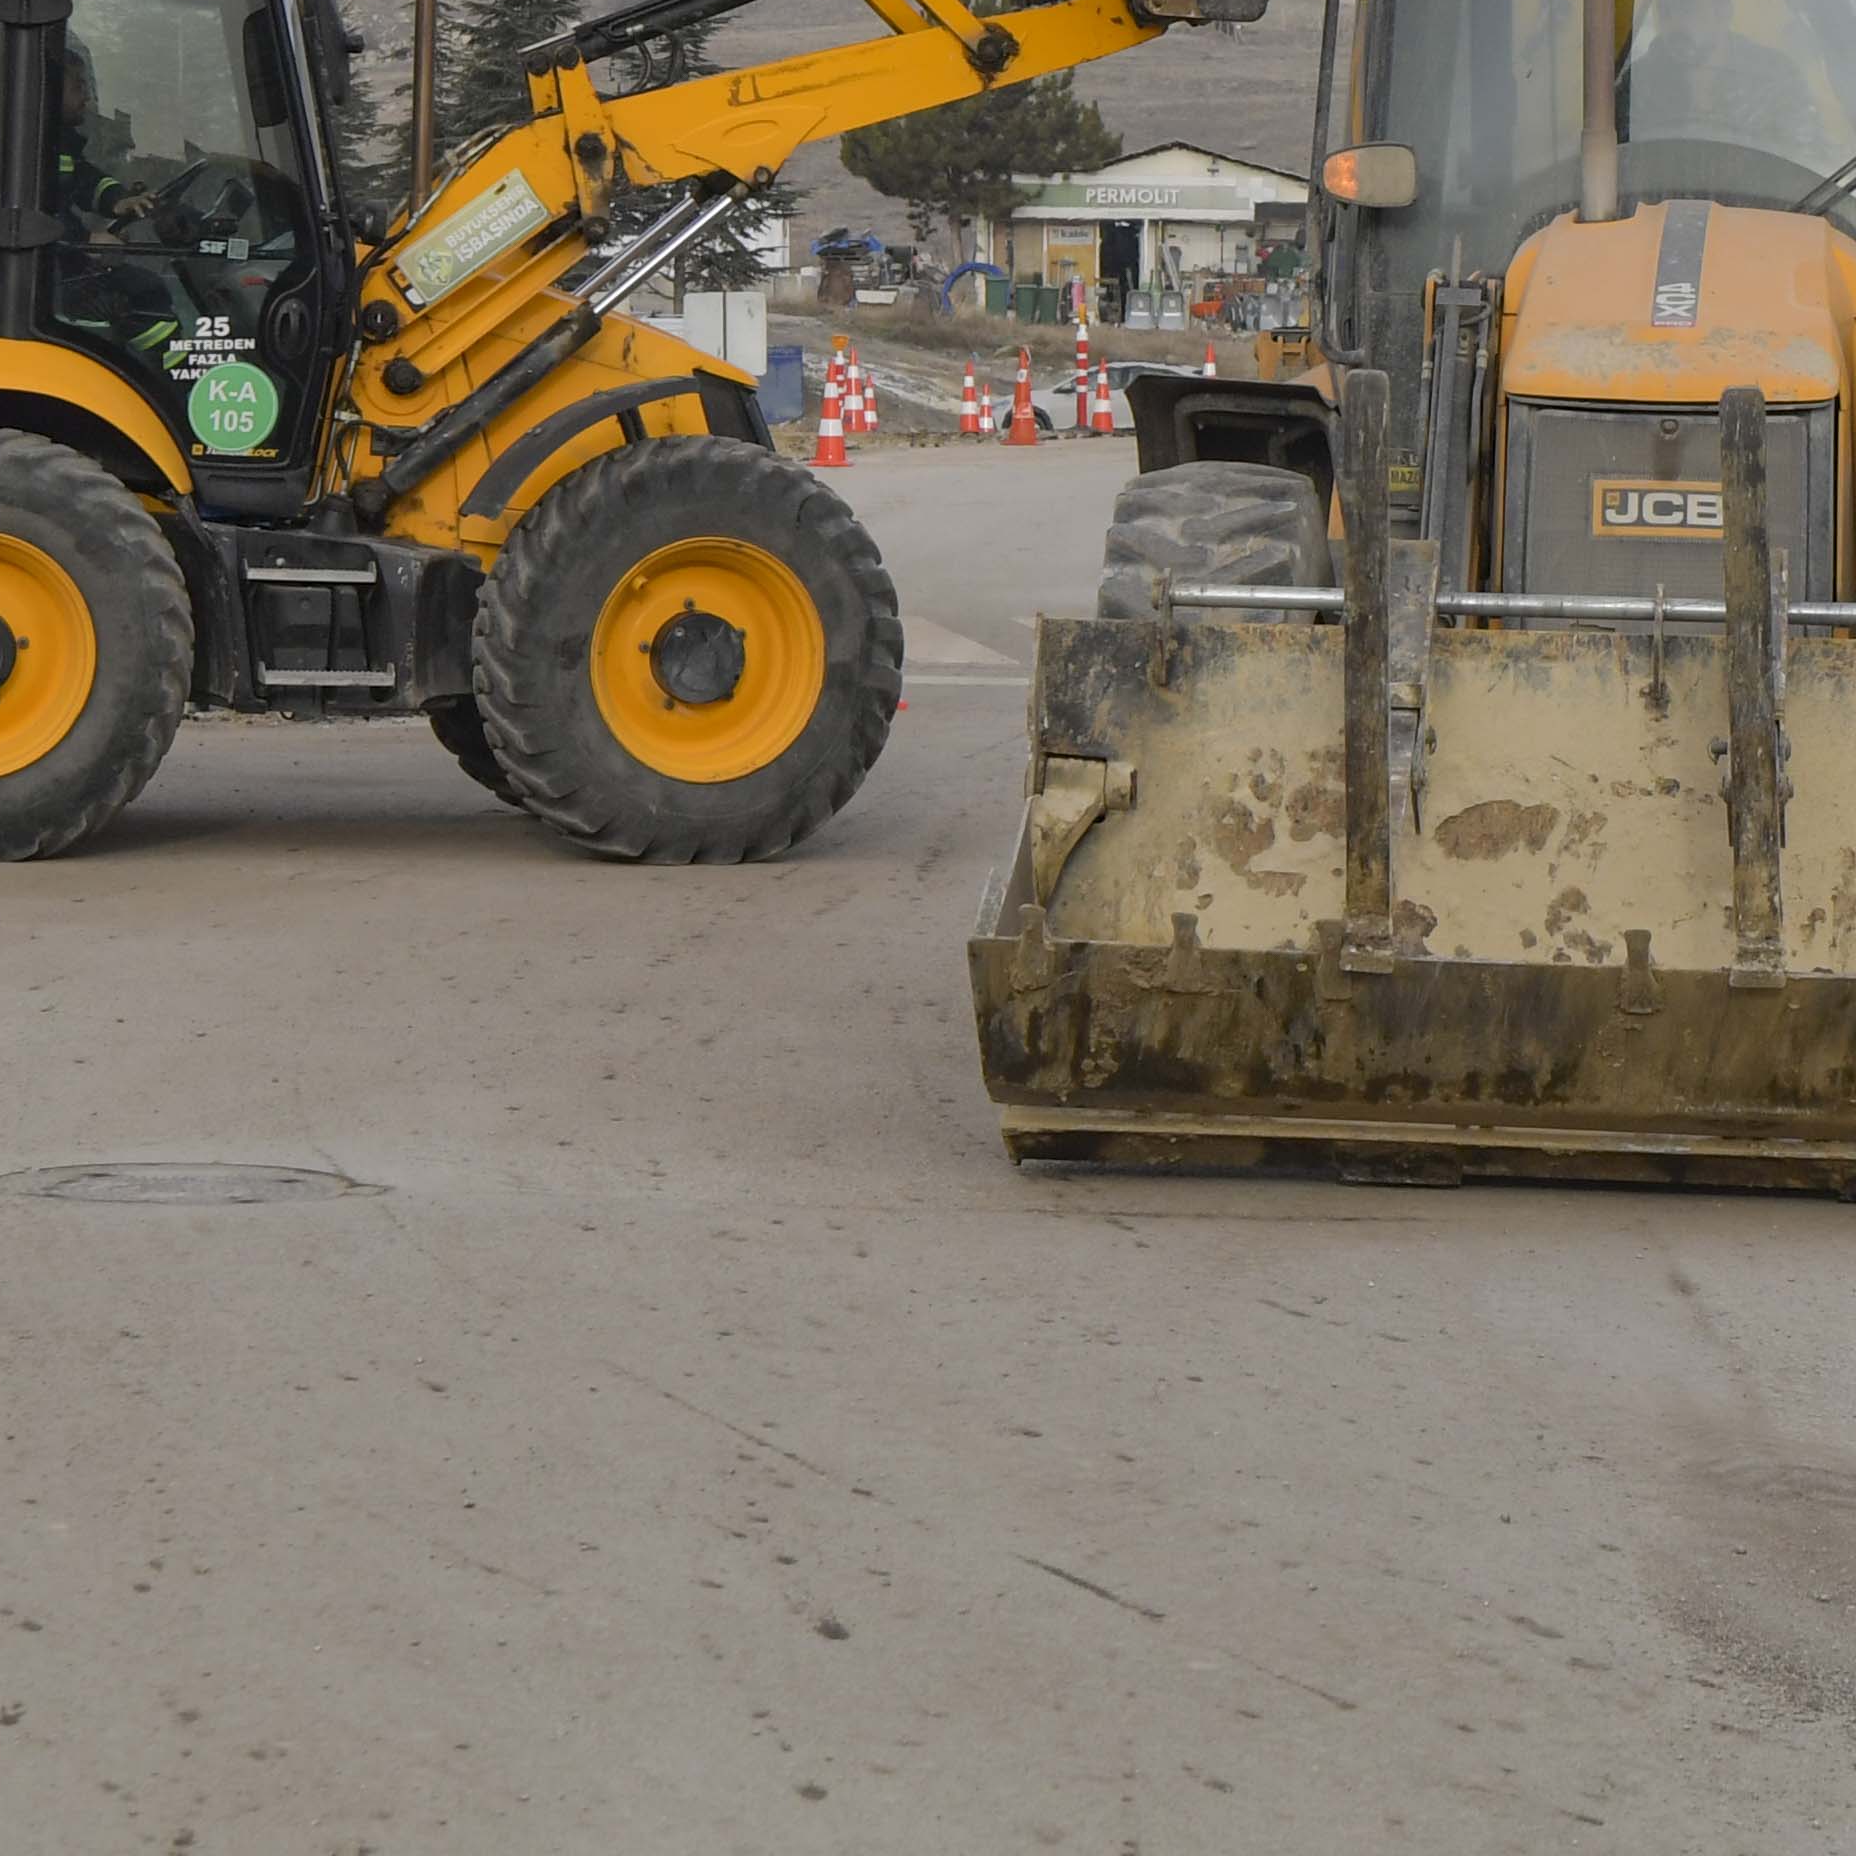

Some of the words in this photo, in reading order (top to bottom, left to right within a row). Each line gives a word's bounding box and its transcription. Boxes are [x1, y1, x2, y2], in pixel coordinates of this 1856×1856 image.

[196, 316, 231, 338] 25
[170, 338, 256, 352] METREDEN
[188, 353, 237, 365] FAZLA
[208, 379, 257, 403] K-A
[210, 409, 255, 433] 105
[1605, 491, 1723, 526] JCB
